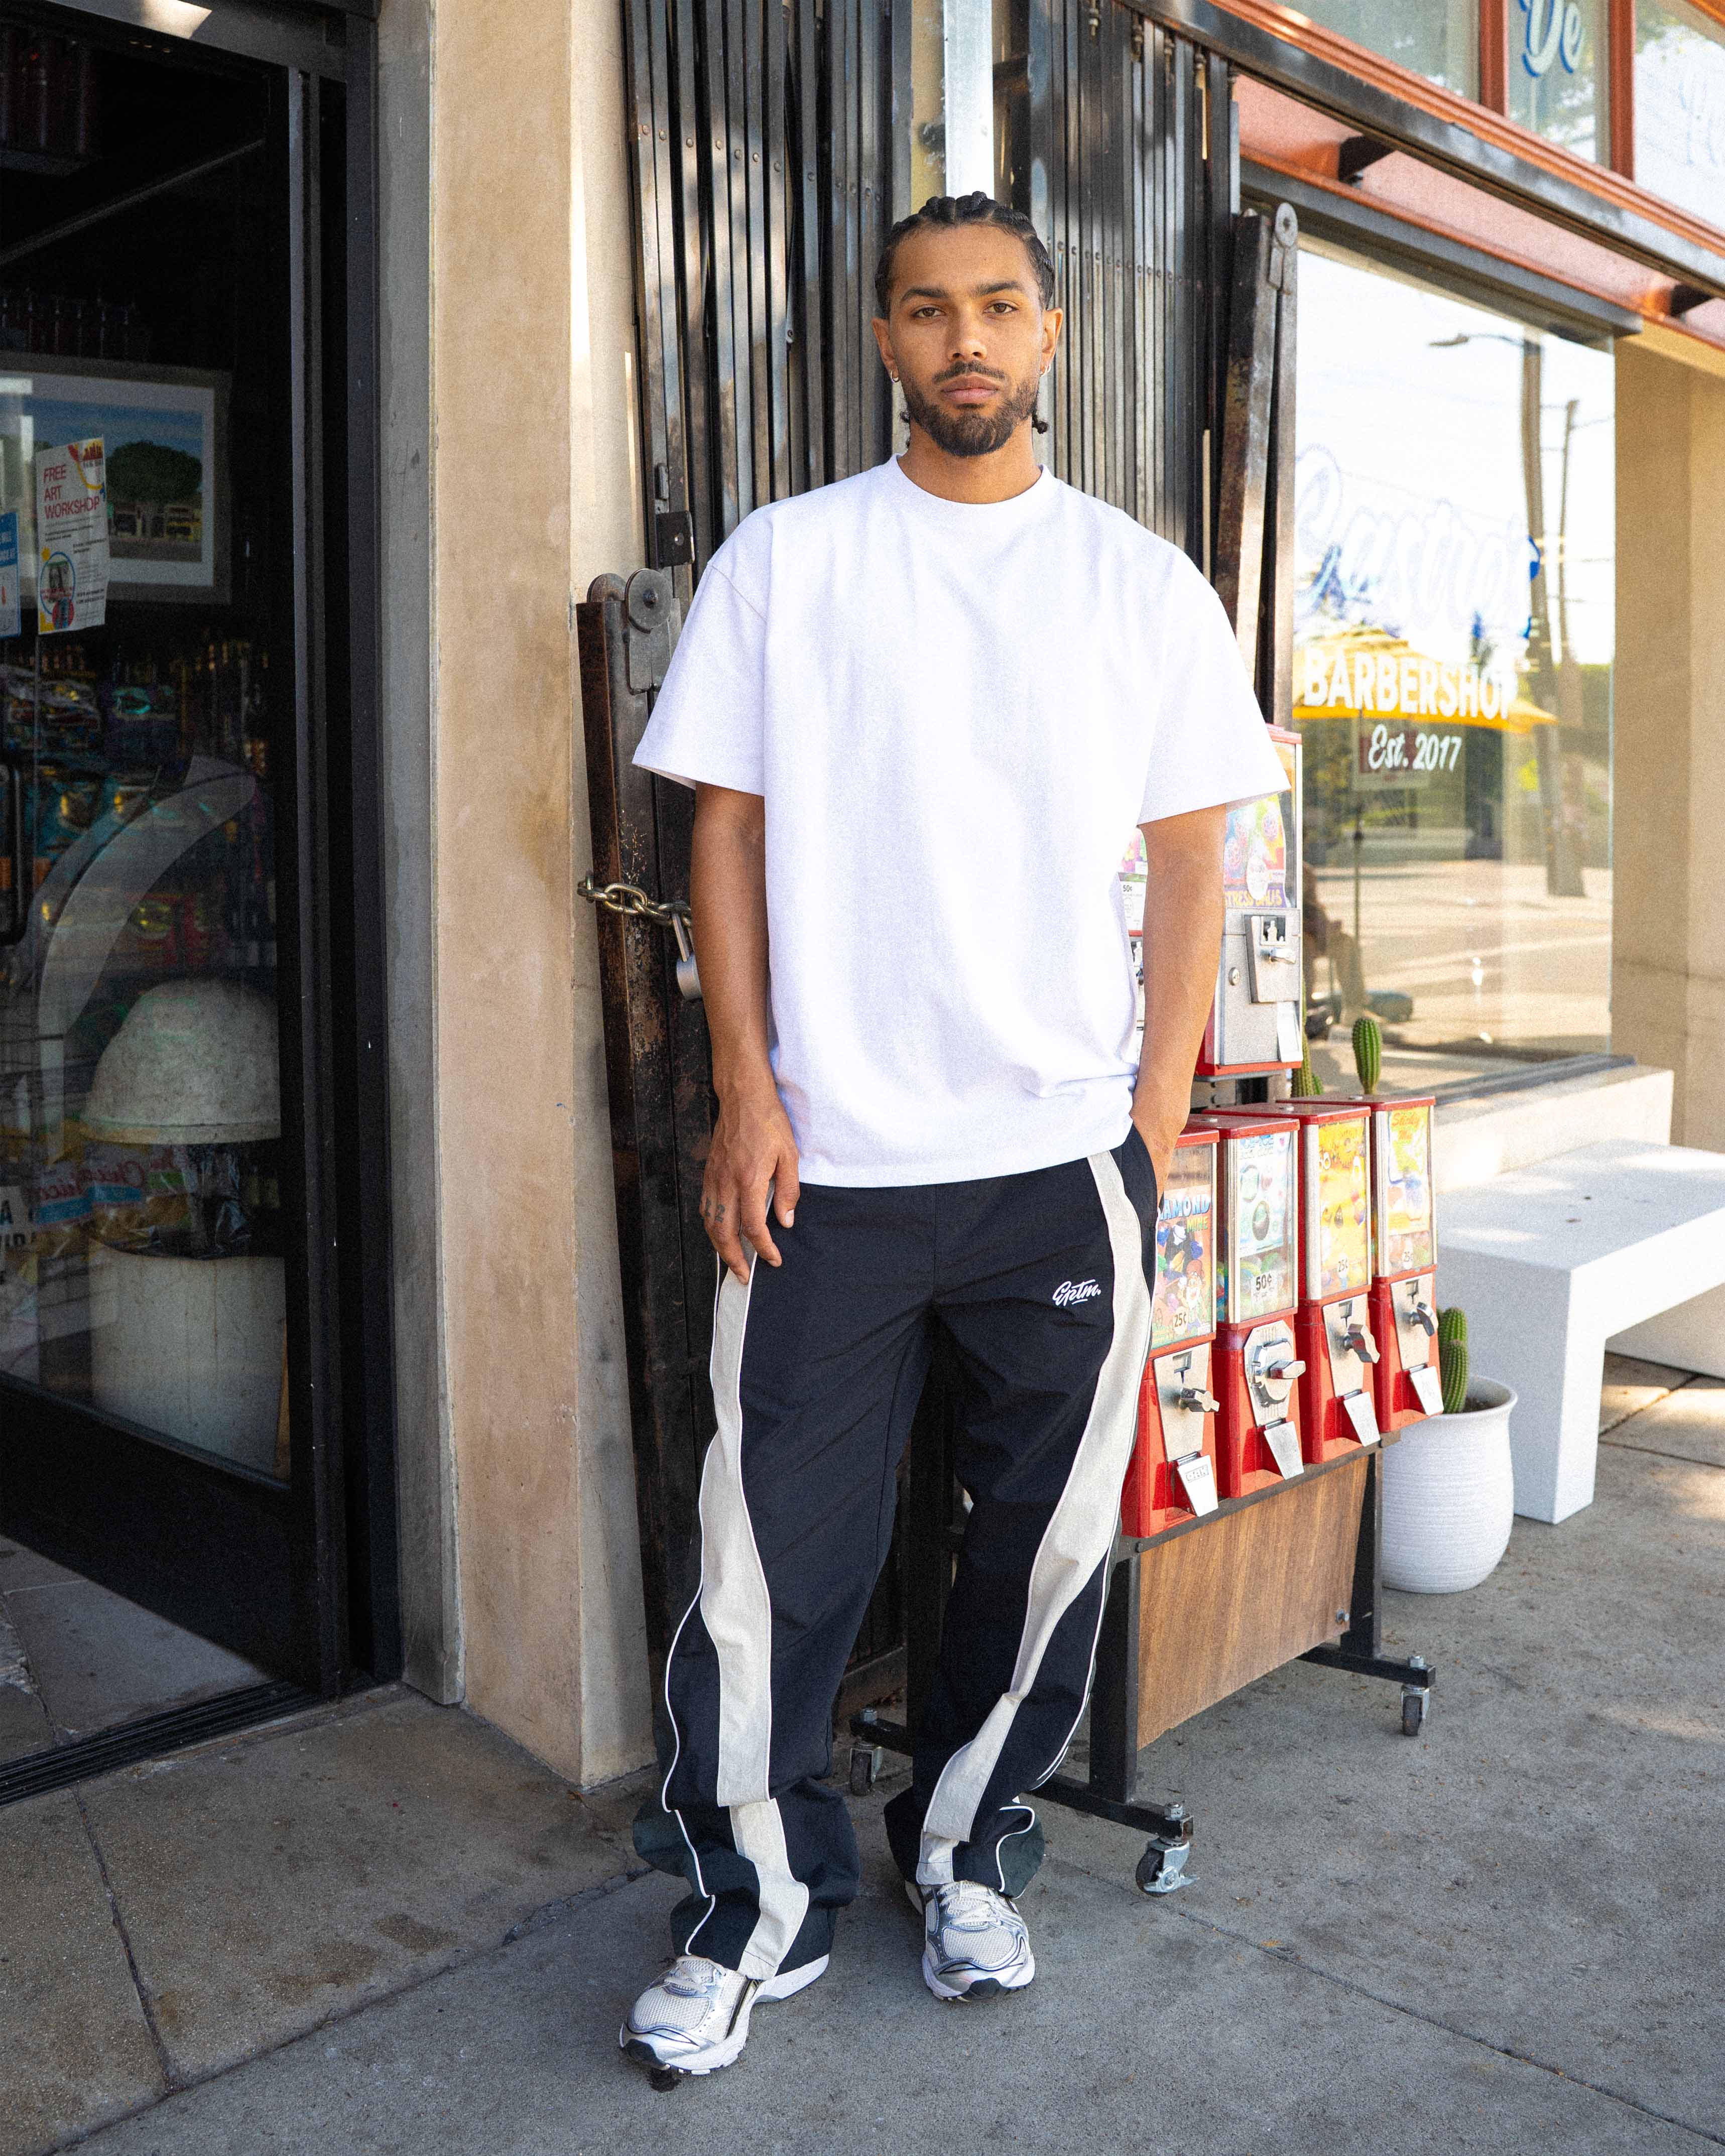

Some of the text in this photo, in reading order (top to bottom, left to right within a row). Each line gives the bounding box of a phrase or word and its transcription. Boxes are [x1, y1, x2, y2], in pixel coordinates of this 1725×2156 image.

[43, 463, 67, 482] FREE
[44, 485, 63, 501] ART
[44, 495, 100, 520] WORKSHOP
[1303, 648, 1518, 720] BARBERSHOP
[1368, 724, 1463, 772] Est. 2017
[1225, 890, 1254, 908] TRESS
[1186, 1216, 1209, 1232] MINE
[1256, 1273, 1272, 1291] 50¢
[1174, 1312, 1187, 1328] 25¢
